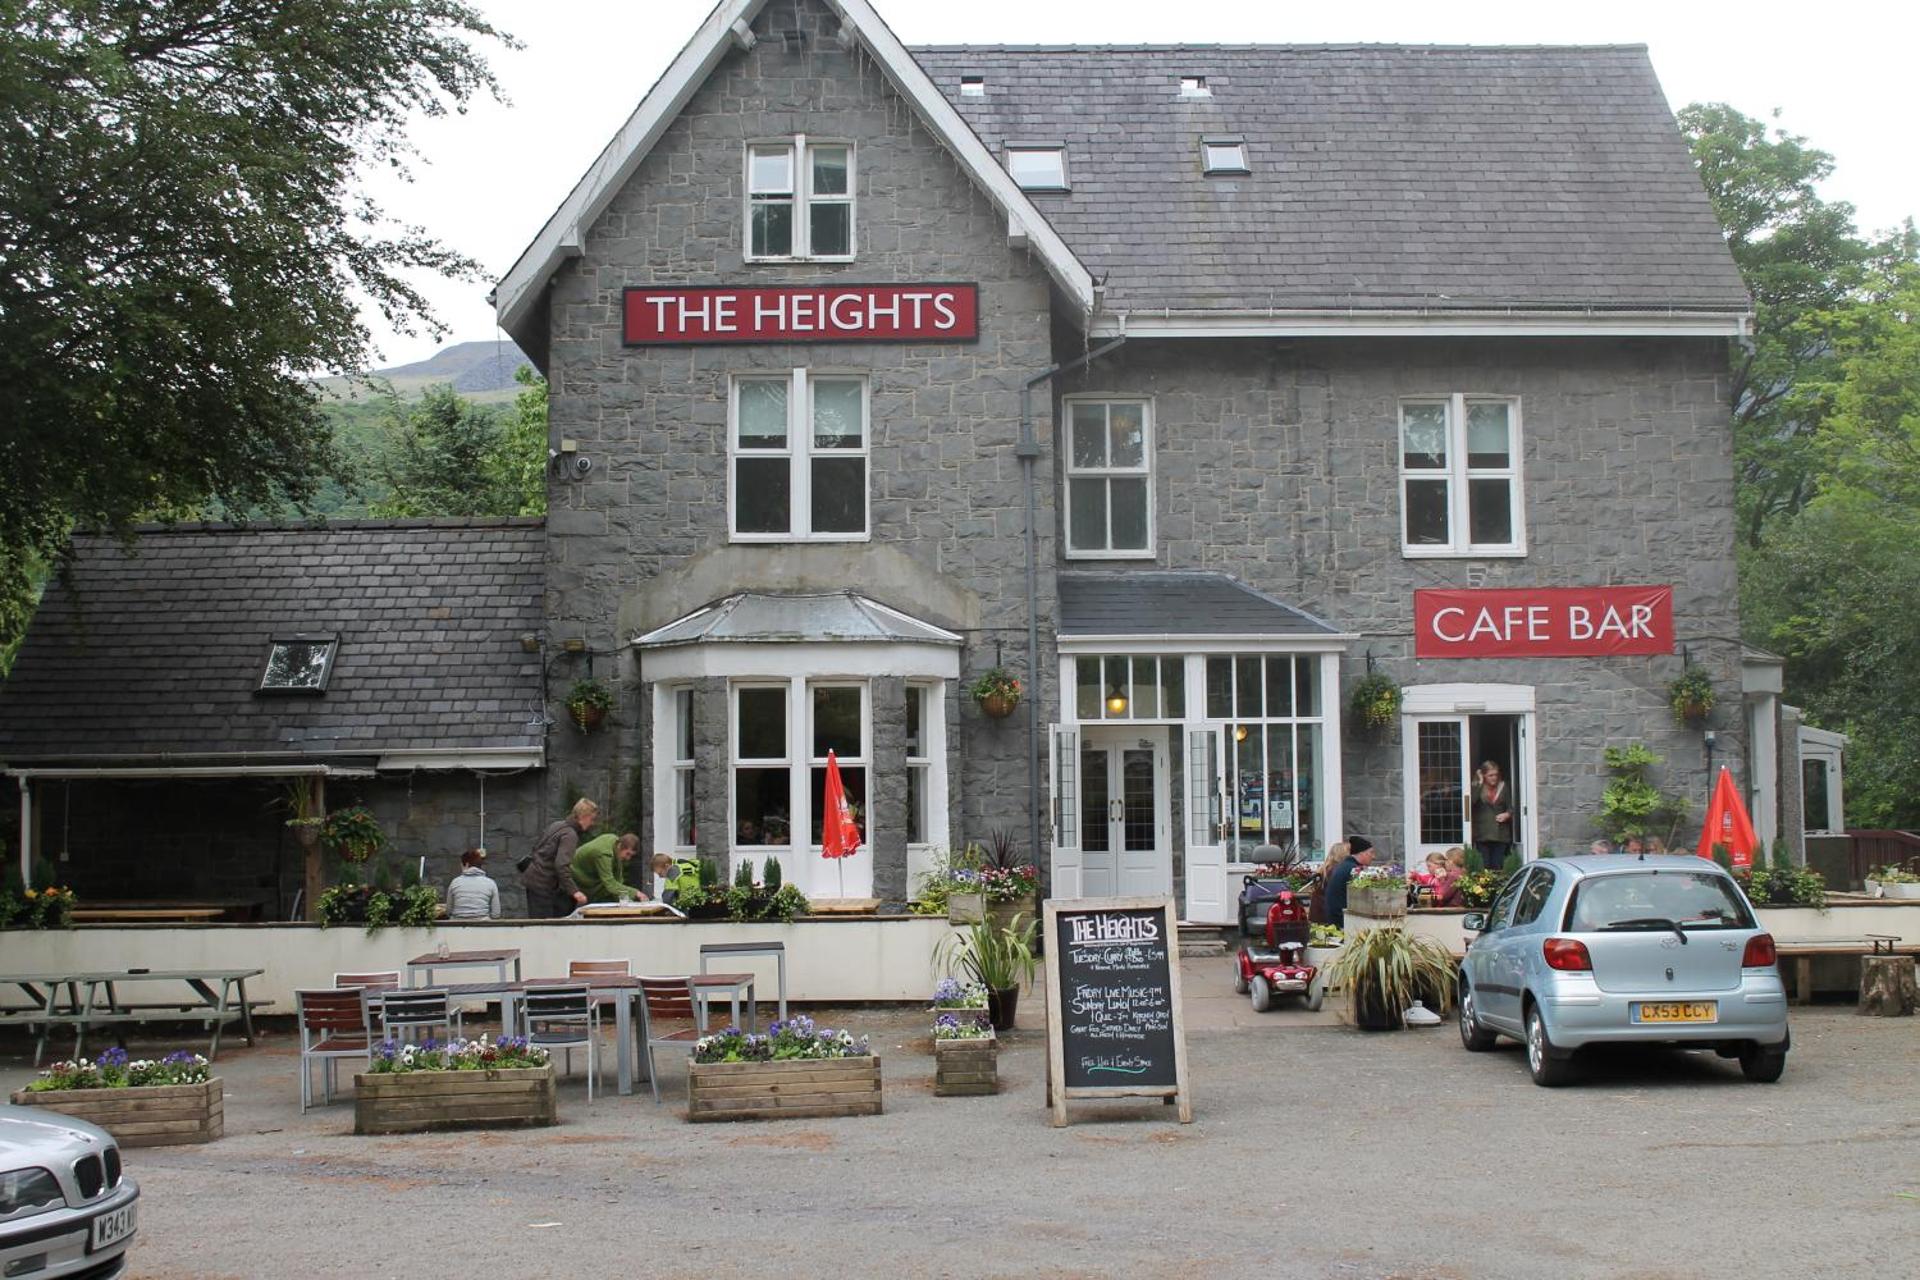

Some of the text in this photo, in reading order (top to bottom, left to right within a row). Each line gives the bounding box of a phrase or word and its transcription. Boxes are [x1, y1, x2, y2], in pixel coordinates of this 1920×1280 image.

[646, 293, 956, 332] THE HEIGHTS
[1432, 604, 1656, 642] CAFE BAR
[1065, 913, 1158, 942] THE HEIGHTS
[1077, 984, 1102, 999] FRIDAY
[1104, 985, 1120, 998] LIVE
[1071, 998, 1105, 1014] SUNDAY
[1107, 998, 1131, 1012] LUNCH
[1641, 1004, 1711, 1018] CX53 CCY
